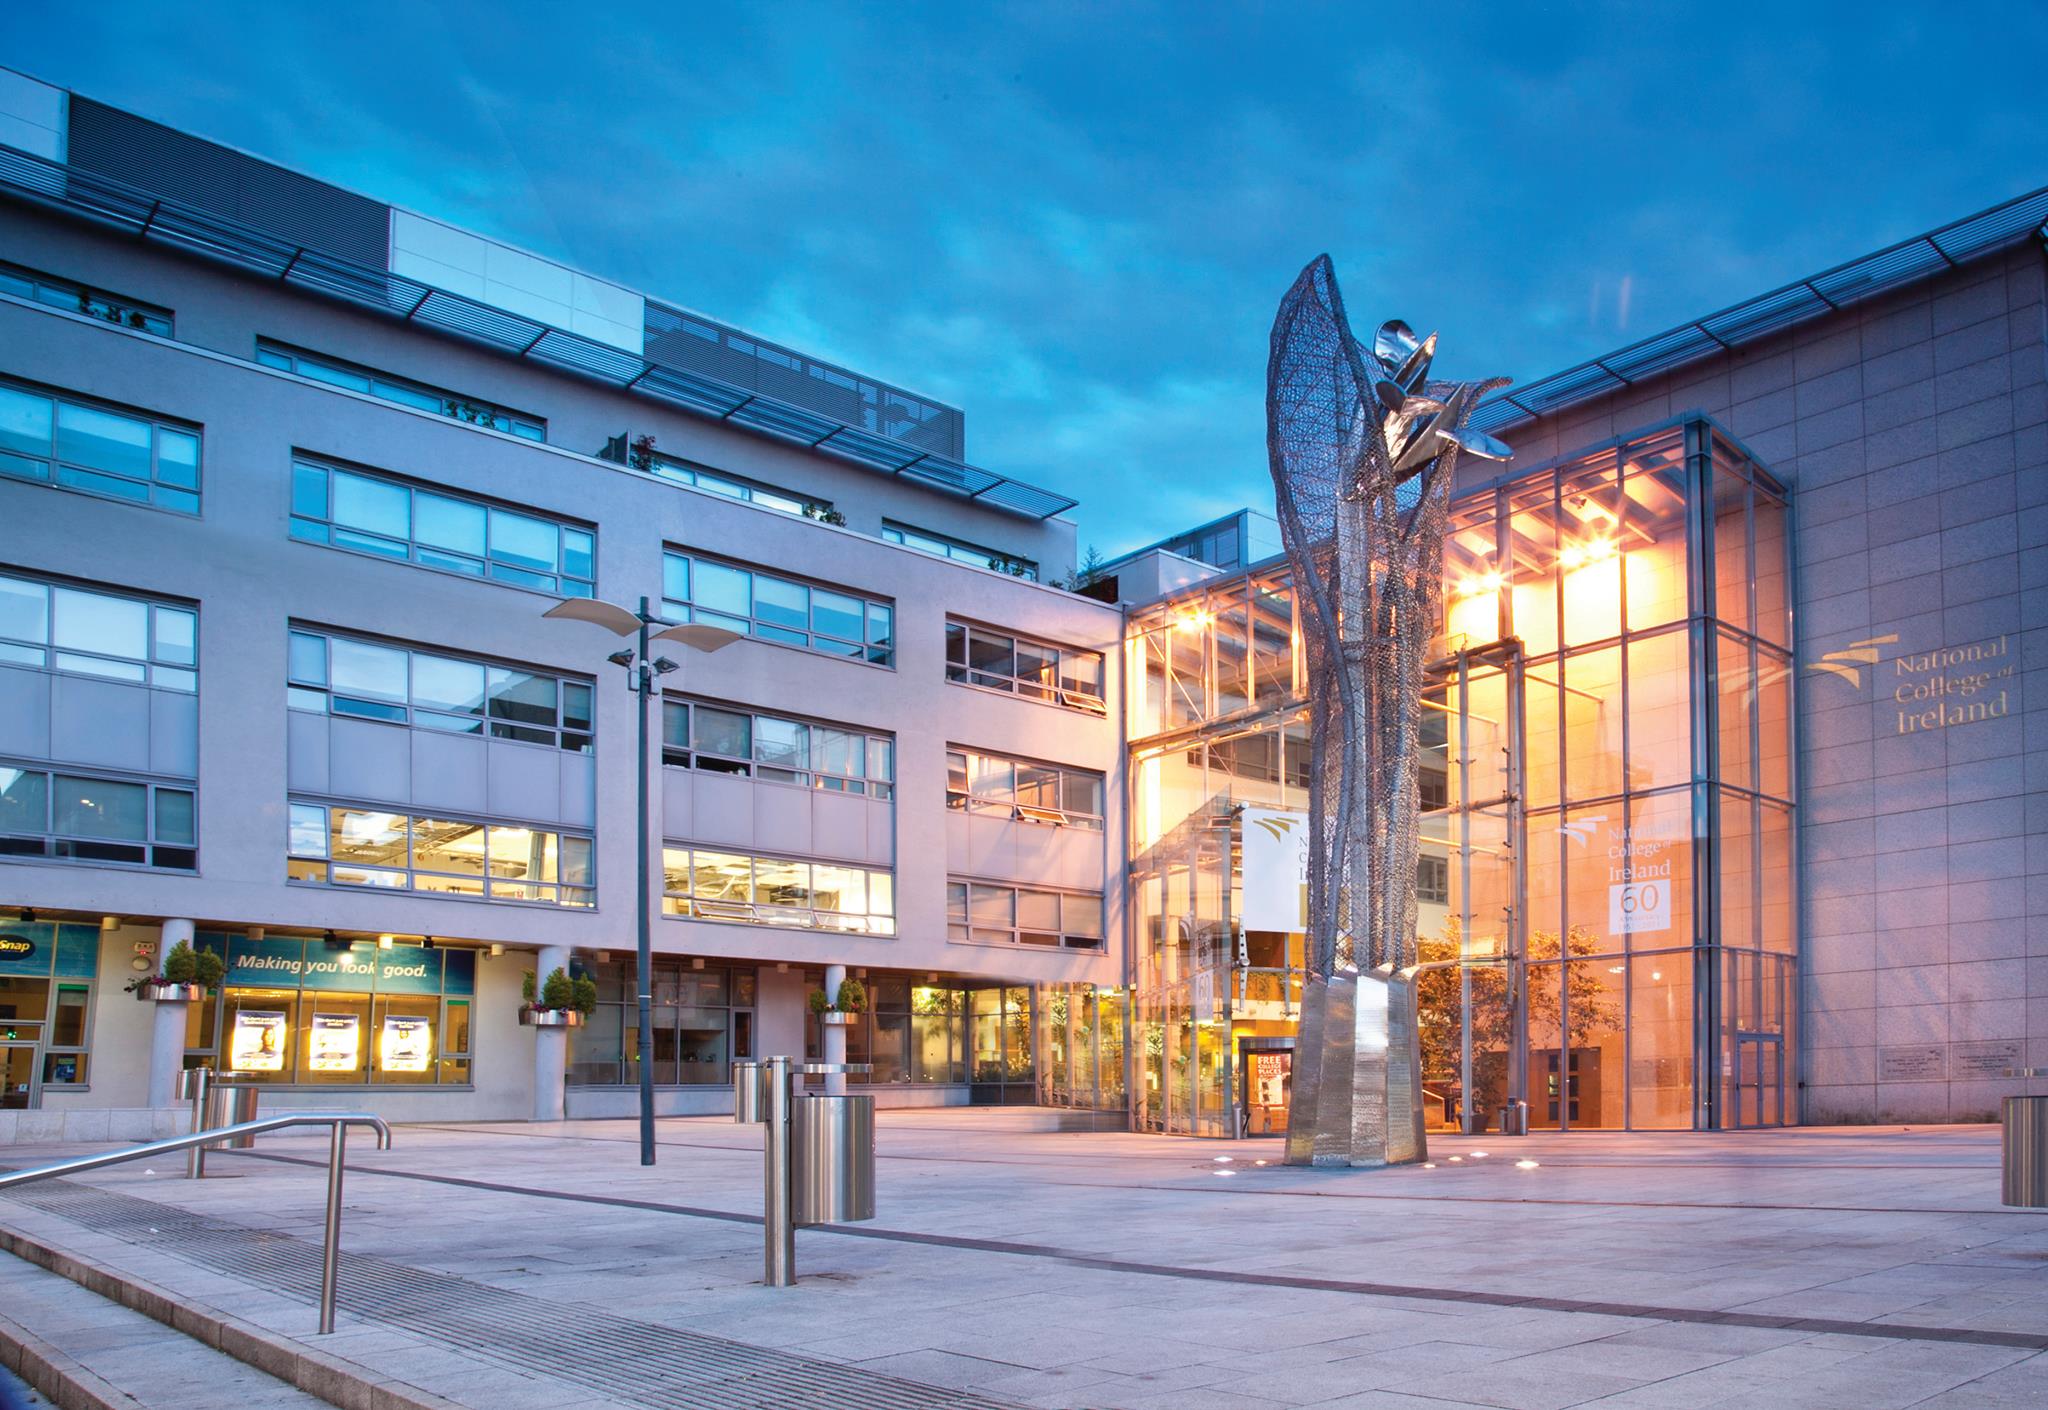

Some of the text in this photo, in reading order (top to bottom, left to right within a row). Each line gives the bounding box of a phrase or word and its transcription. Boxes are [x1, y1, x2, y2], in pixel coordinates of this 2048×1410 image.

[1896, 635, 2007, 676] National
[1896, 664, 2014, 703] College of
[1897, 690, 2008, 735] Ireland
[1608, 842, 1661, 859] College
[1608, 859, 1671, 881] Ireland
[1620, 884, 1659, 913] 60
[0, 940, 30, 953] Snap
[236, 955, 427, 978] Making you look good.
[1257, 1055, 1281, 1064] FREE
